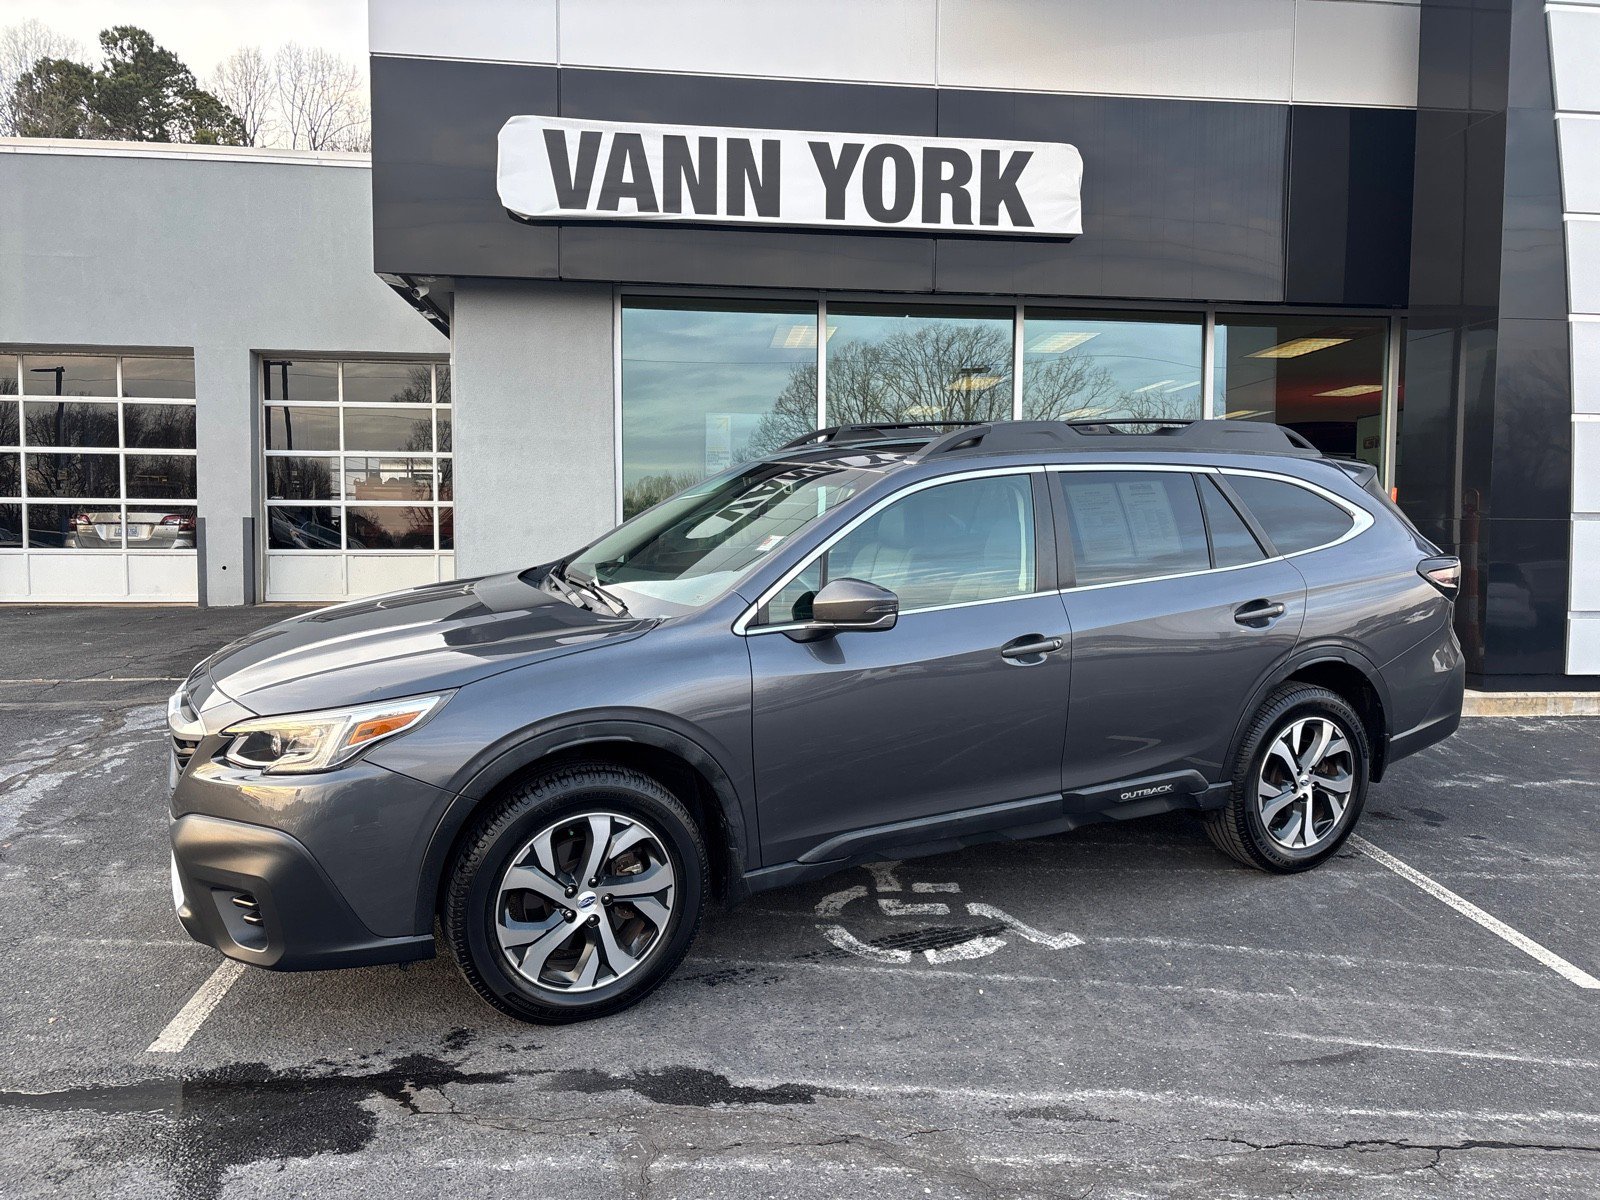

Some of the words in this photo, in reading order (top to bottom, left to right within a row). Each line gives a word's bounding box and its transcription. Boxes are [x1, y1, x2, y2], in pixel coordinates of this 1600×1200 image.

[542, 129, 781, 218] VANN
[807, 141, 1035, 228] YORK
[1120, 784, 1173, 800] OUTBACK
